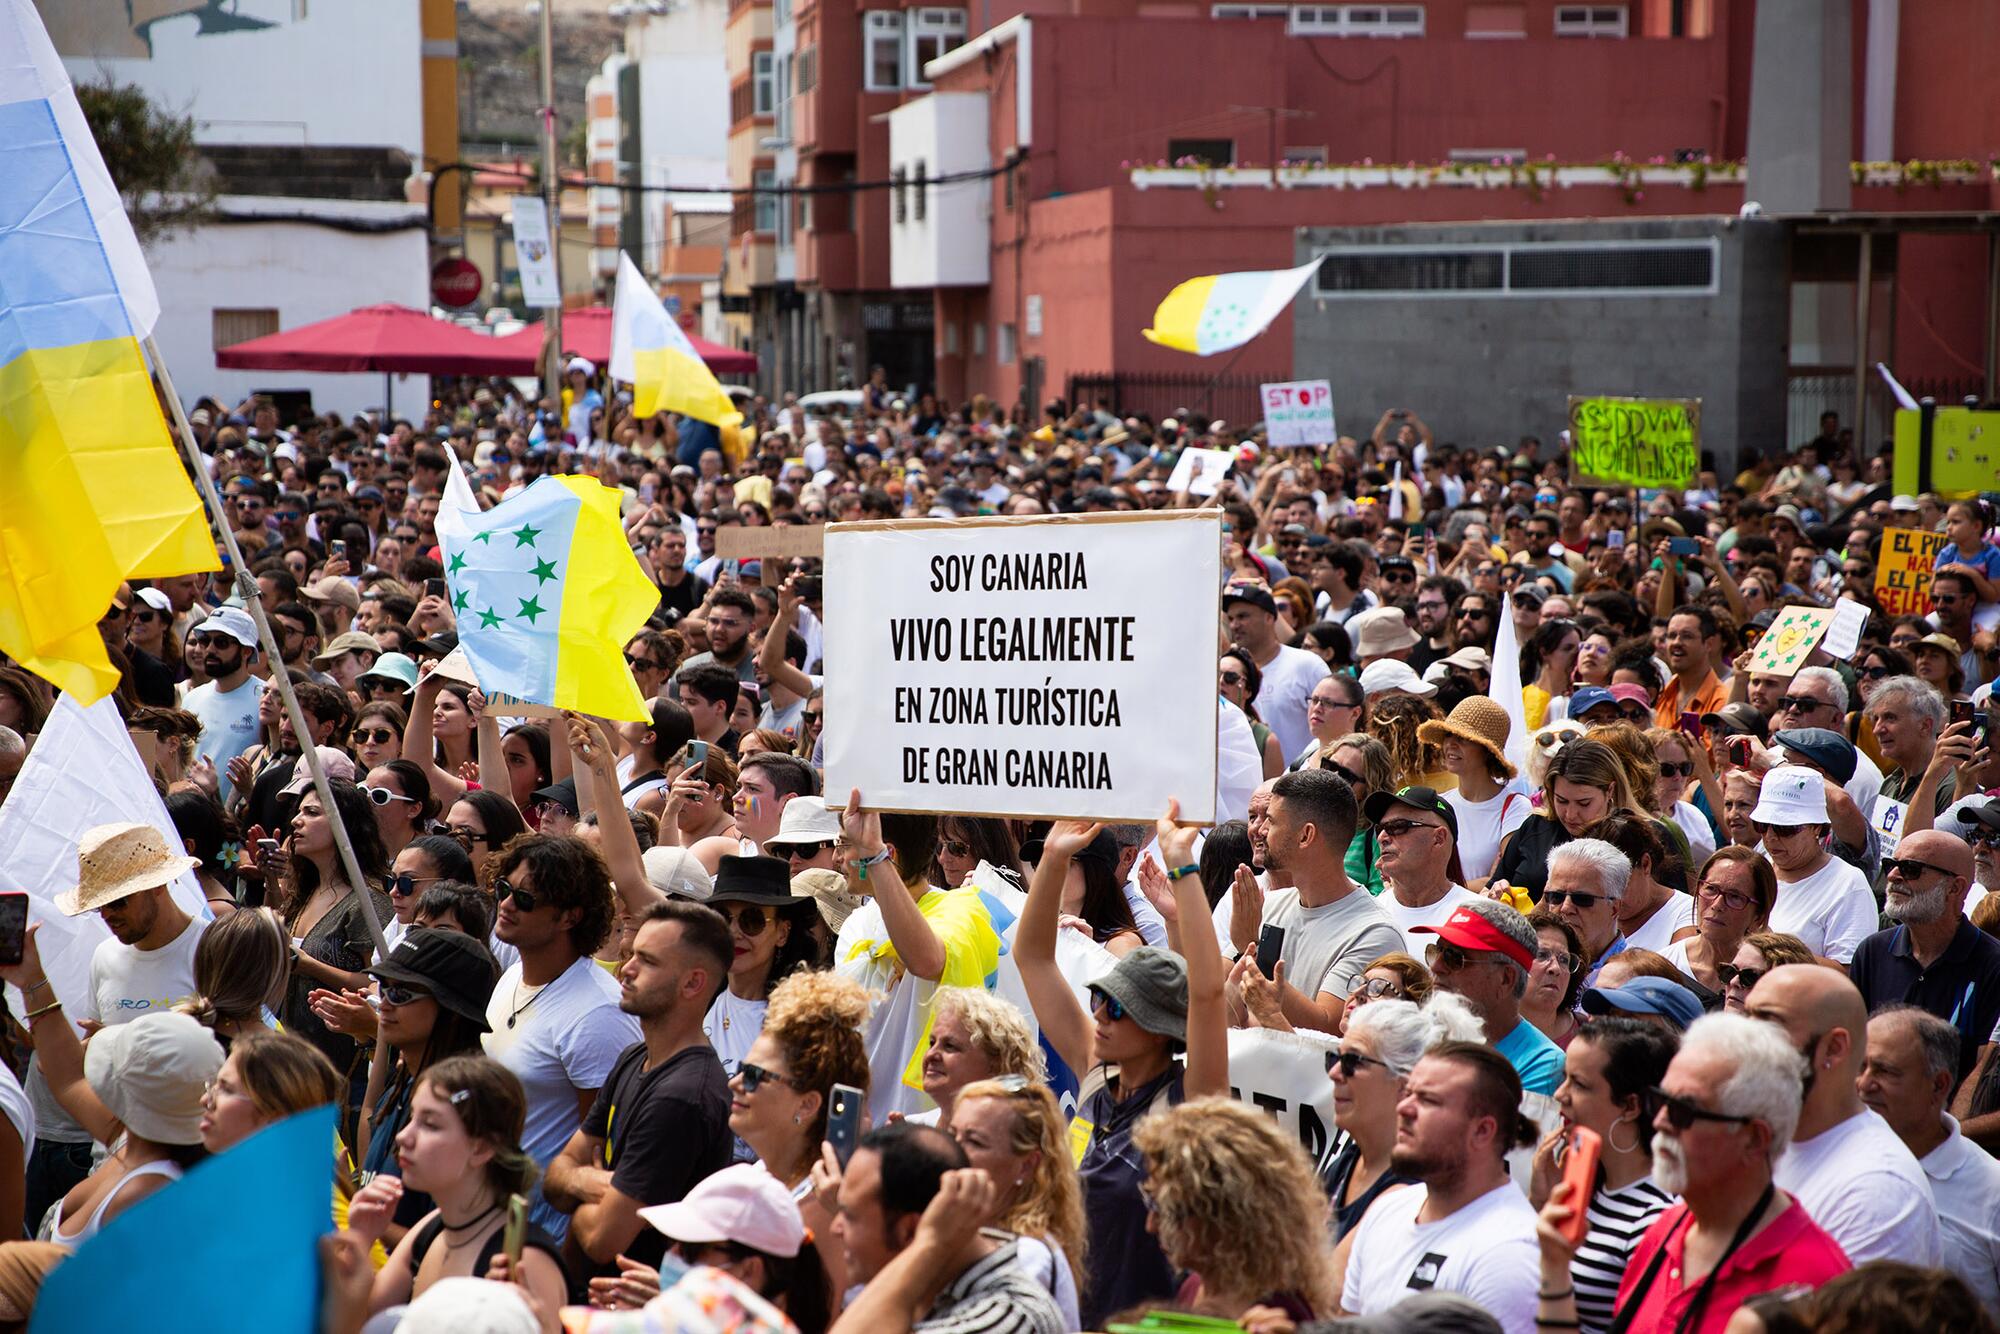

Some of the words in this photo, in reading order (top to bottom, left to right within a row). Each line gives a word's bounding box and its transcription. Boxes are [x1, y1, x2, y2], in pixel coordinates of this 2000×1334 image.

[1268, 386, 1329, 408] STOP
[1894, 533, 1914, 553] EL
[930, 554, 975, 593] SOY
[981, 552, 1088, 592] CANARIA
[1888, 570, 1911, 589] EL
[890, 618, 952, 662] VIVO
[960, 616, 1136, 662] LEGALMENTE
[895, 687, 922, 724] EN
[928, 687, 989, 725] ZONA
[995, 676, 1121, 727] TURÍSTICA
[903, 747, 930, 784] DE
[935, 747, 998, 786] GRAN
[1005, 749, 1113, 790] CANARIA
